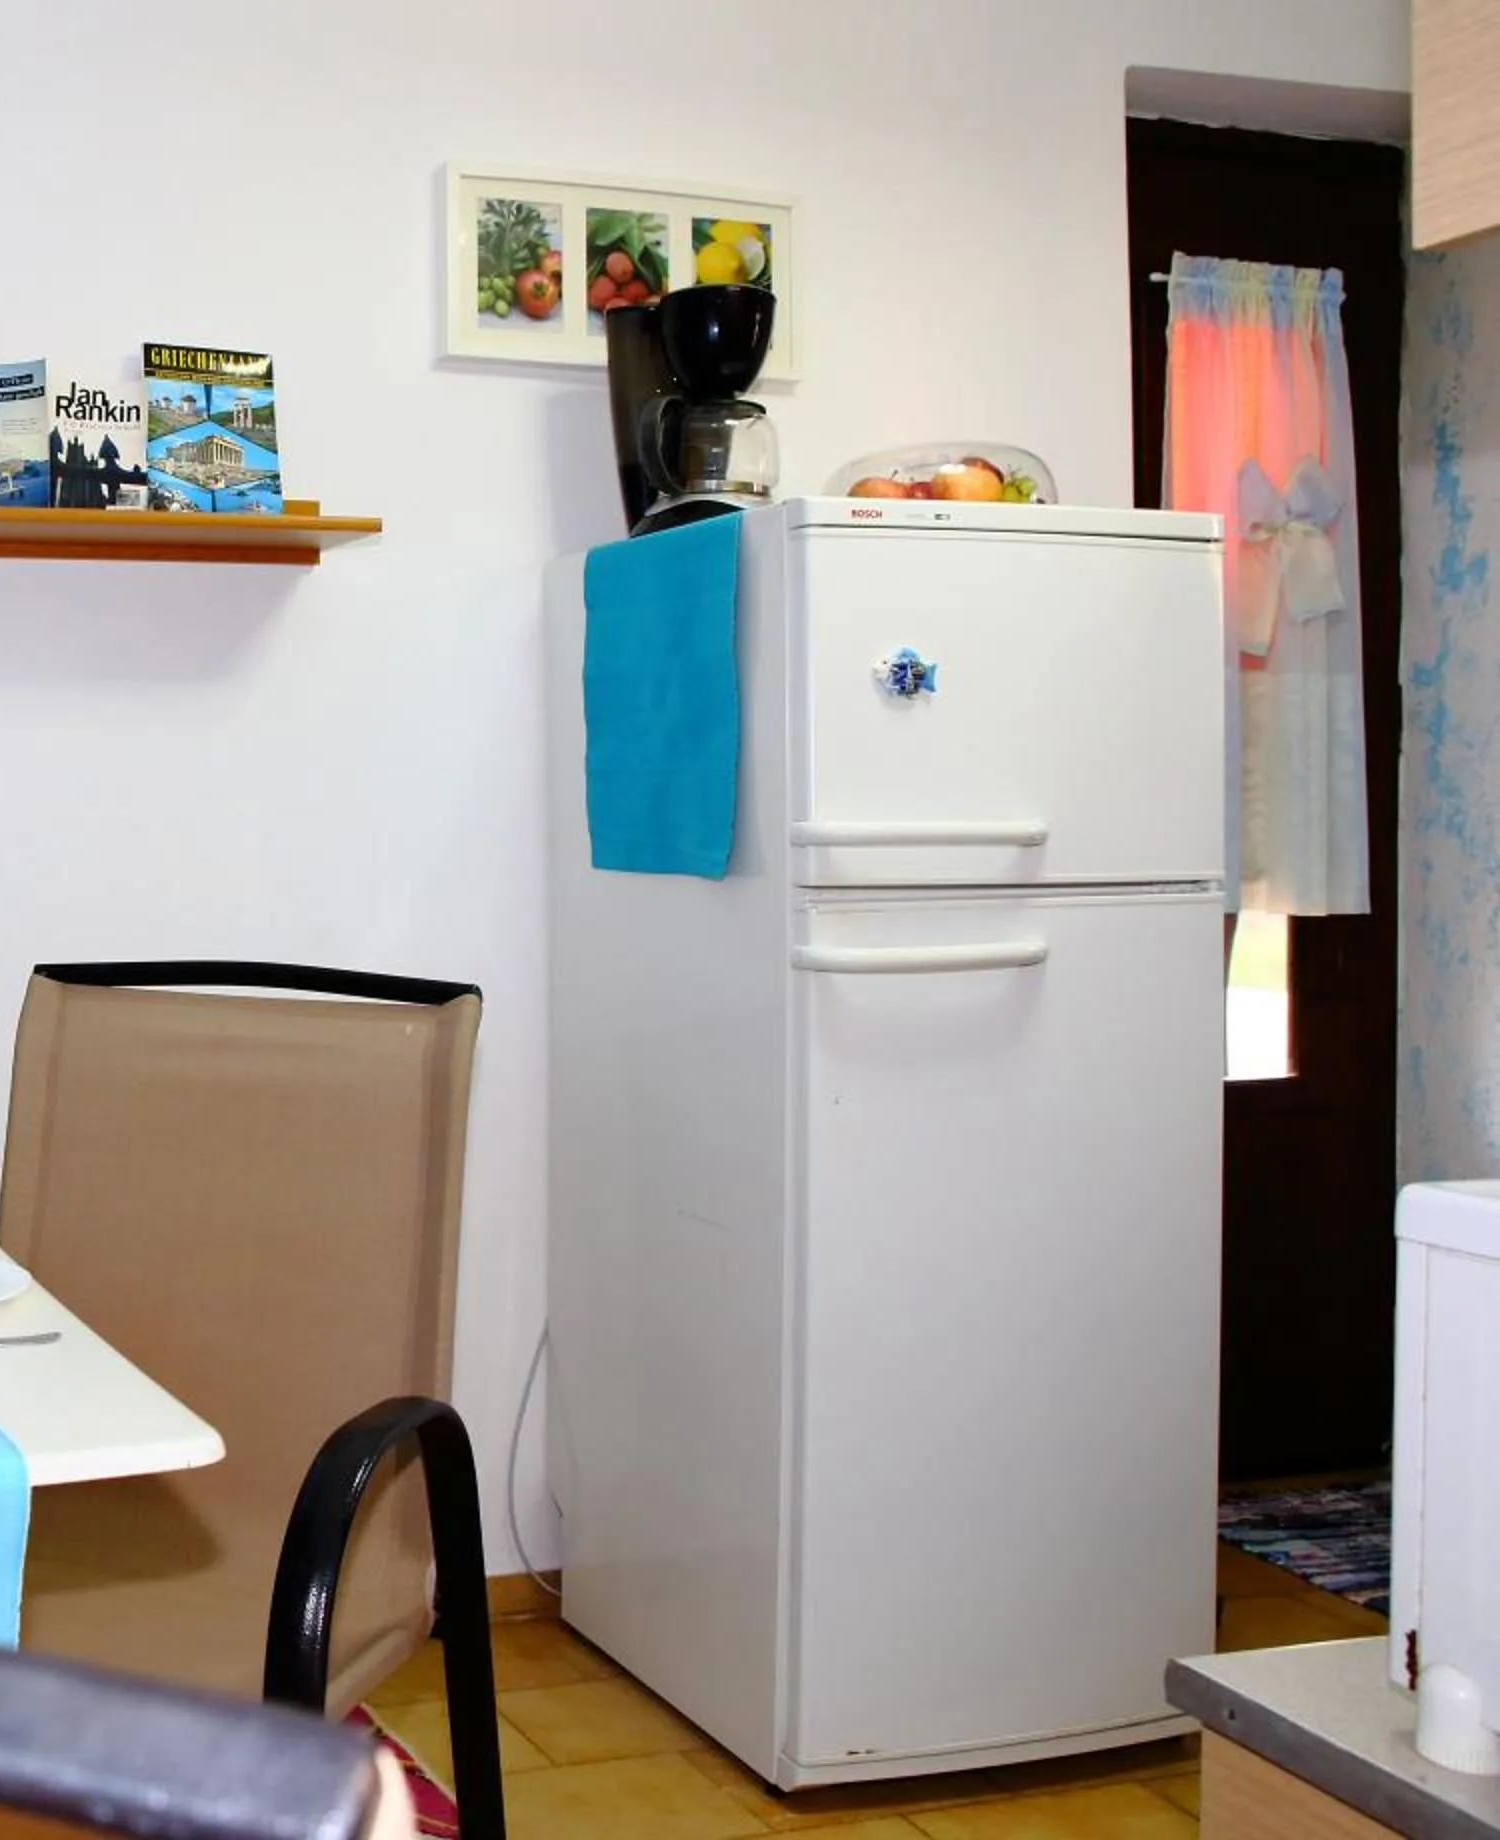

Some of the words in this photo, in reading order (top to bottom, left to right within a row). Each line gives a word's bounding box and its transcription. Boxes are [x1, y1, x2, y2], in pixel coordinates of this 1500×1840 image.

[151, 347, 267, 373] GRIECHEN
[56, 395, 140, 422] Rankin
[851, 509, 882, 519] BOSCH
